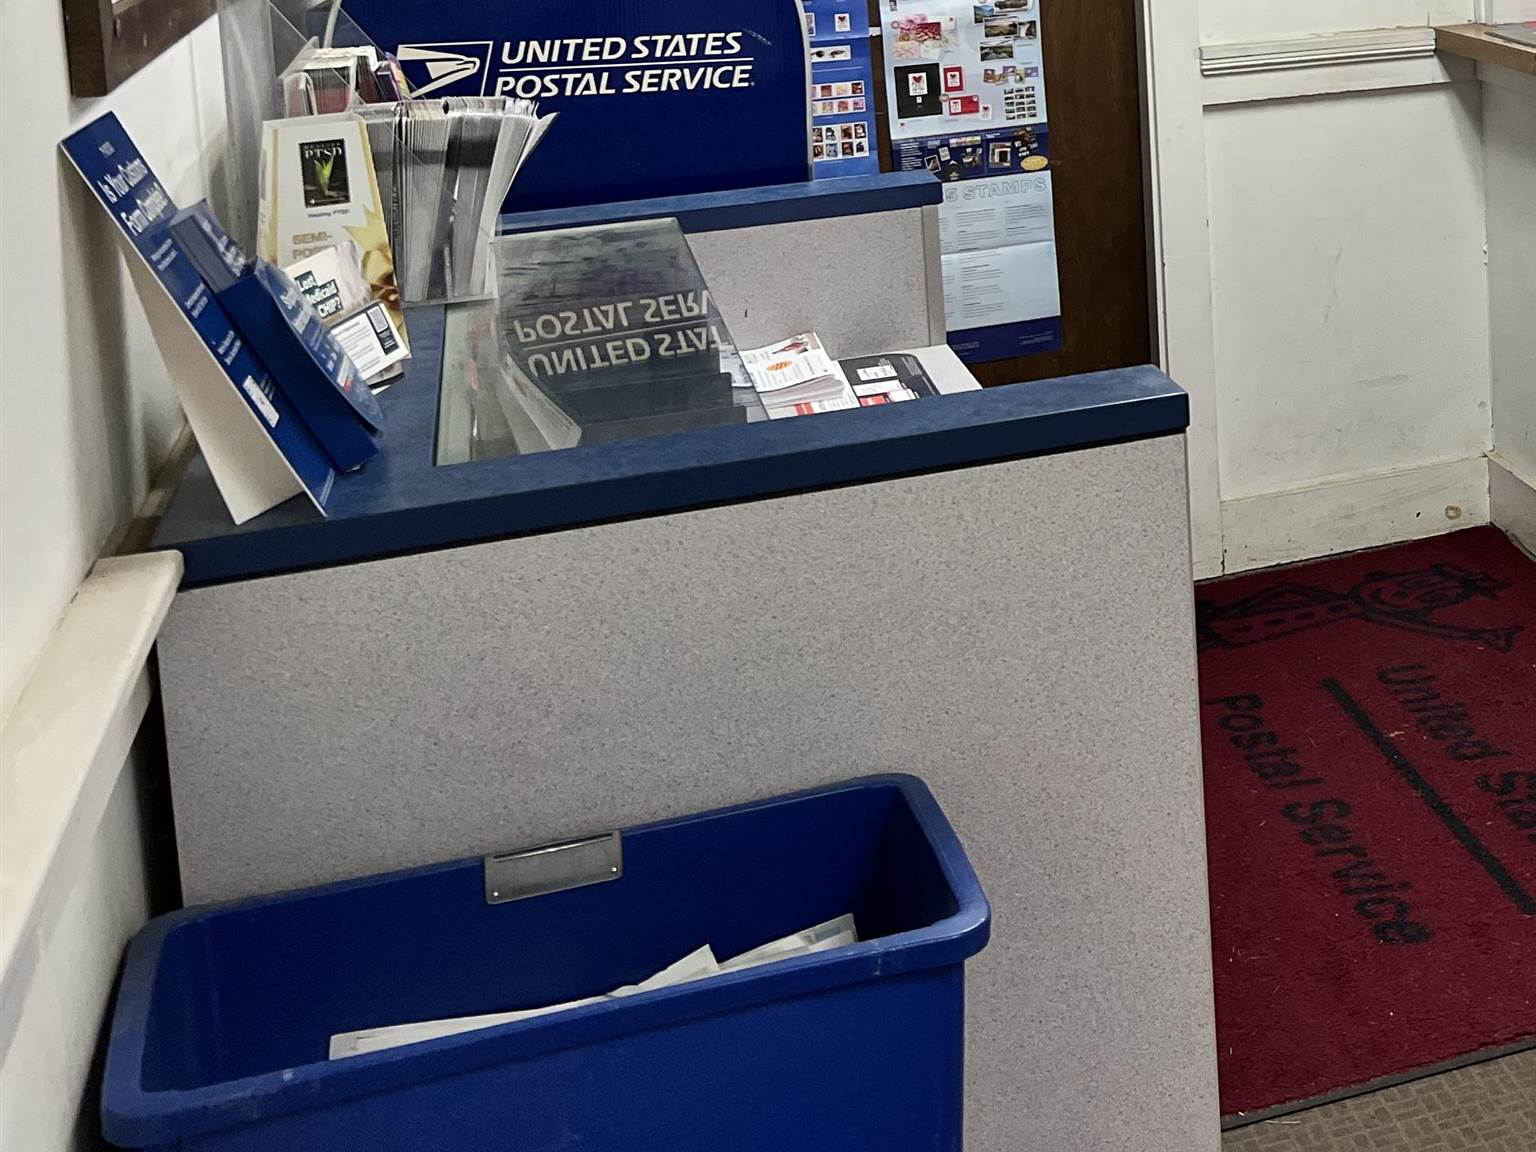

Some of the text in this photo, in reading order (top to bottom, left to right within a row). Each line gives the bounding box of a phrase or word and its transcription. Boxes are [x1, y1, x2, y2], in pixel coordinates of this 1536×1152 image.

[501, 31, 743, 65] UNITED STATES
[496, 65, 754, 99] POSTAL SERVICE
[304, 146, 342, 159] PTSD
[1375, 662, 1510, 761] United
[1206, 693, 1433, 946] Postal Service
